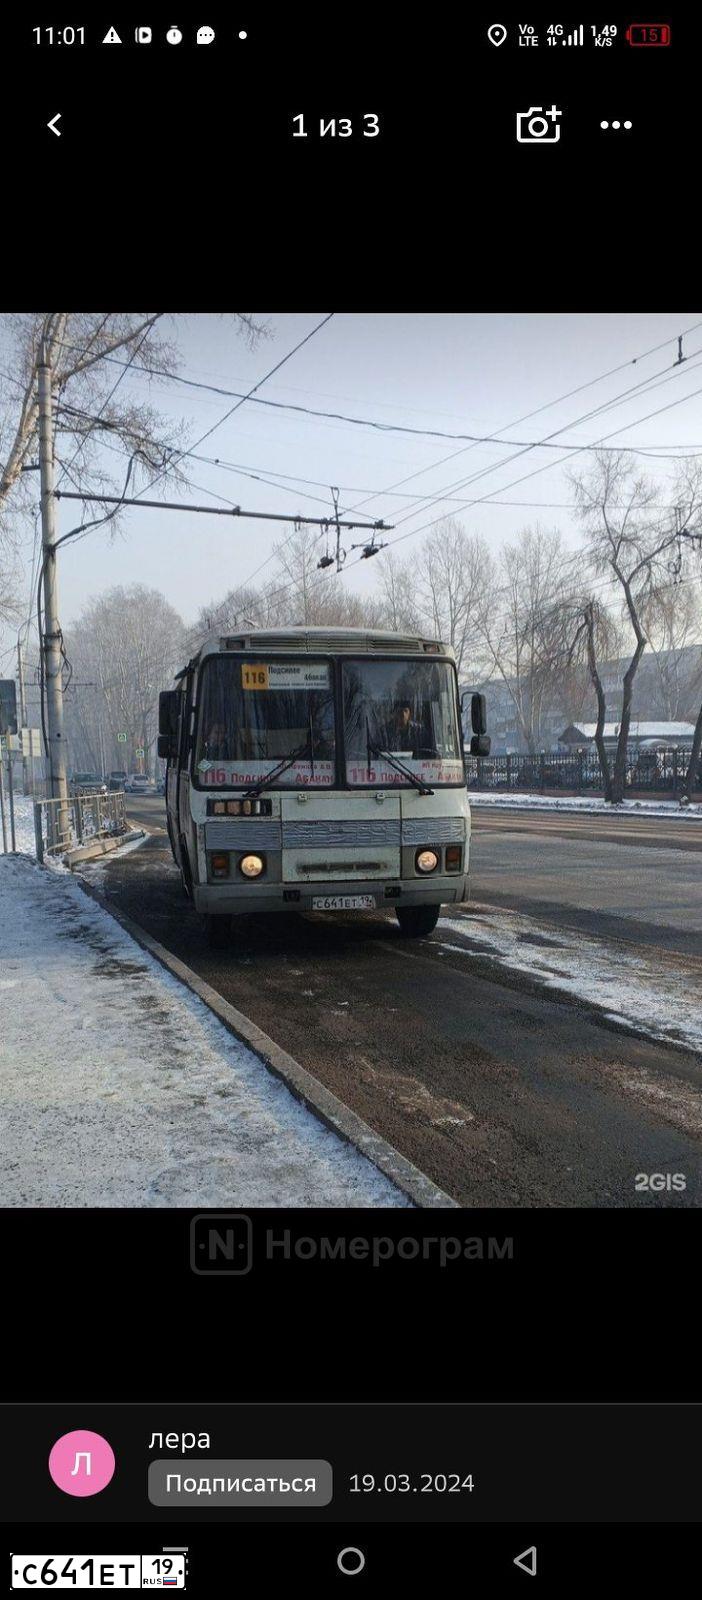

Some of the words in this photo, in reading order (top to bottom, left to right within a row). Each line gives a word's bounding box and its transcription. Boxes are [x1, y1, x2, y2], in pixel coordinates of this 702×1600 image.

[32, 26, 85, 45] 11:01
[518, 24, 535, 35] Vo
[546, 24, 564, 36] 4G
[641, 28, 658, 42] 15
[518, 35, 539, 47] LTE
[594, 37, 613, 47] K/S
[292, 113, 308, 137] 1
[319, 118, 353, 138] из
[363, 113, 380, 138] 3
[244, 671, 266, 684] 116
[203, 767, 227, 784] 116
[350, 767, 377, 783] 116
[148, 1432, 211, 1455] лера
[70, 1452, 92, 1476] Л
[166, 1474, 317, 1496] Подписаться
[349, 1473, 475, 1493] 19.03.2024
